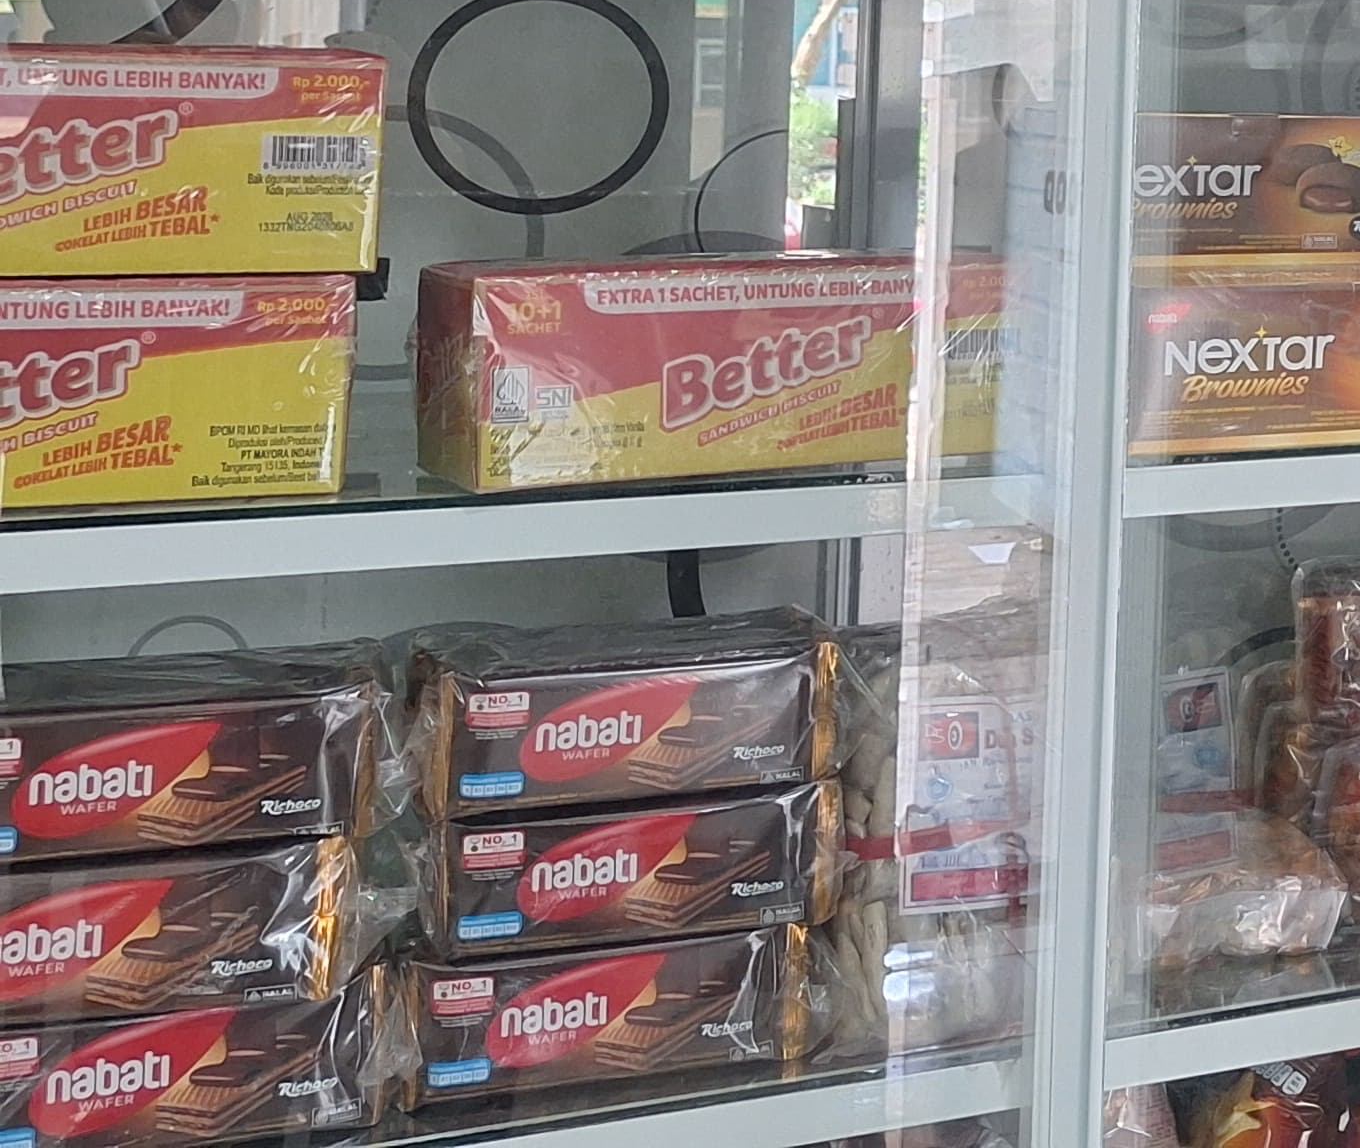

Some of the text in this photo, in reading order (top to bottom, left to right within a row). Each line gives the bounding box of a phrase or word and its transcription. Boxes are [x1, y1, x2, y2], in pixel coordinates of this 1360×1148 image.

[18, 68, 108, 88] UUNG
[114, 69, 175, 89] LEBIH
[178, 71, 266, 90] BANYAK!
[63, 180, 137, 212] BISCUIT
[84, 185, 208, 232] LEBIH BESAR
[55, 233, 110, 252] COKELAT
[111, 226, 146, 242] LEBIH
[597, 279, 916, 305] EXTRA 1 SACHET, UNTUNG LEBIH BANY
[75, 300, 135, 319] LEBIH
[141, 298, 231, 318] BANYAK!
[507, 323, 562, 335] SACHET
[663, 316, 870, 430] Better
[536, 387, 571, 407] SNI
[1181, 373, 1309, 404] Brownies
[698, 380, 842, 447] SANDWICH BISCUIT
[22, 411, 99, 446] BISCUIT
[43, 439, 92, 467] LEBIH
[96, 415, 172, 454] BESAR
[14, 465, 69, 489] COKELAT
[72, 457, 107, 476] LEBIH
[535, 710, 642, 753] nabati
[562, 748, 611, 761] WAFER
[733, 743, 786, 761] Richoco
[28, 759, 154, 806] nabati
[60, 801, 117, 817] WAFER
[261, 798, 322, 816] Richoco
[531, 848, 639, 893] nabati
[557, 885, 608, 902] WAFER
[731, 880, 784, 897] Richoco
[8, 961, 65, 978] WAFER
[211, 958, 274, 975] Richoco
[501, 991, 608, 1039] nabati
[528, 1030, 578, 1048] WAFER
[46, 1050, 171, 1105] nabati
[278, 1076, 339, 1096] Richoco
[78, 1094, 135, 1115] WAFER
